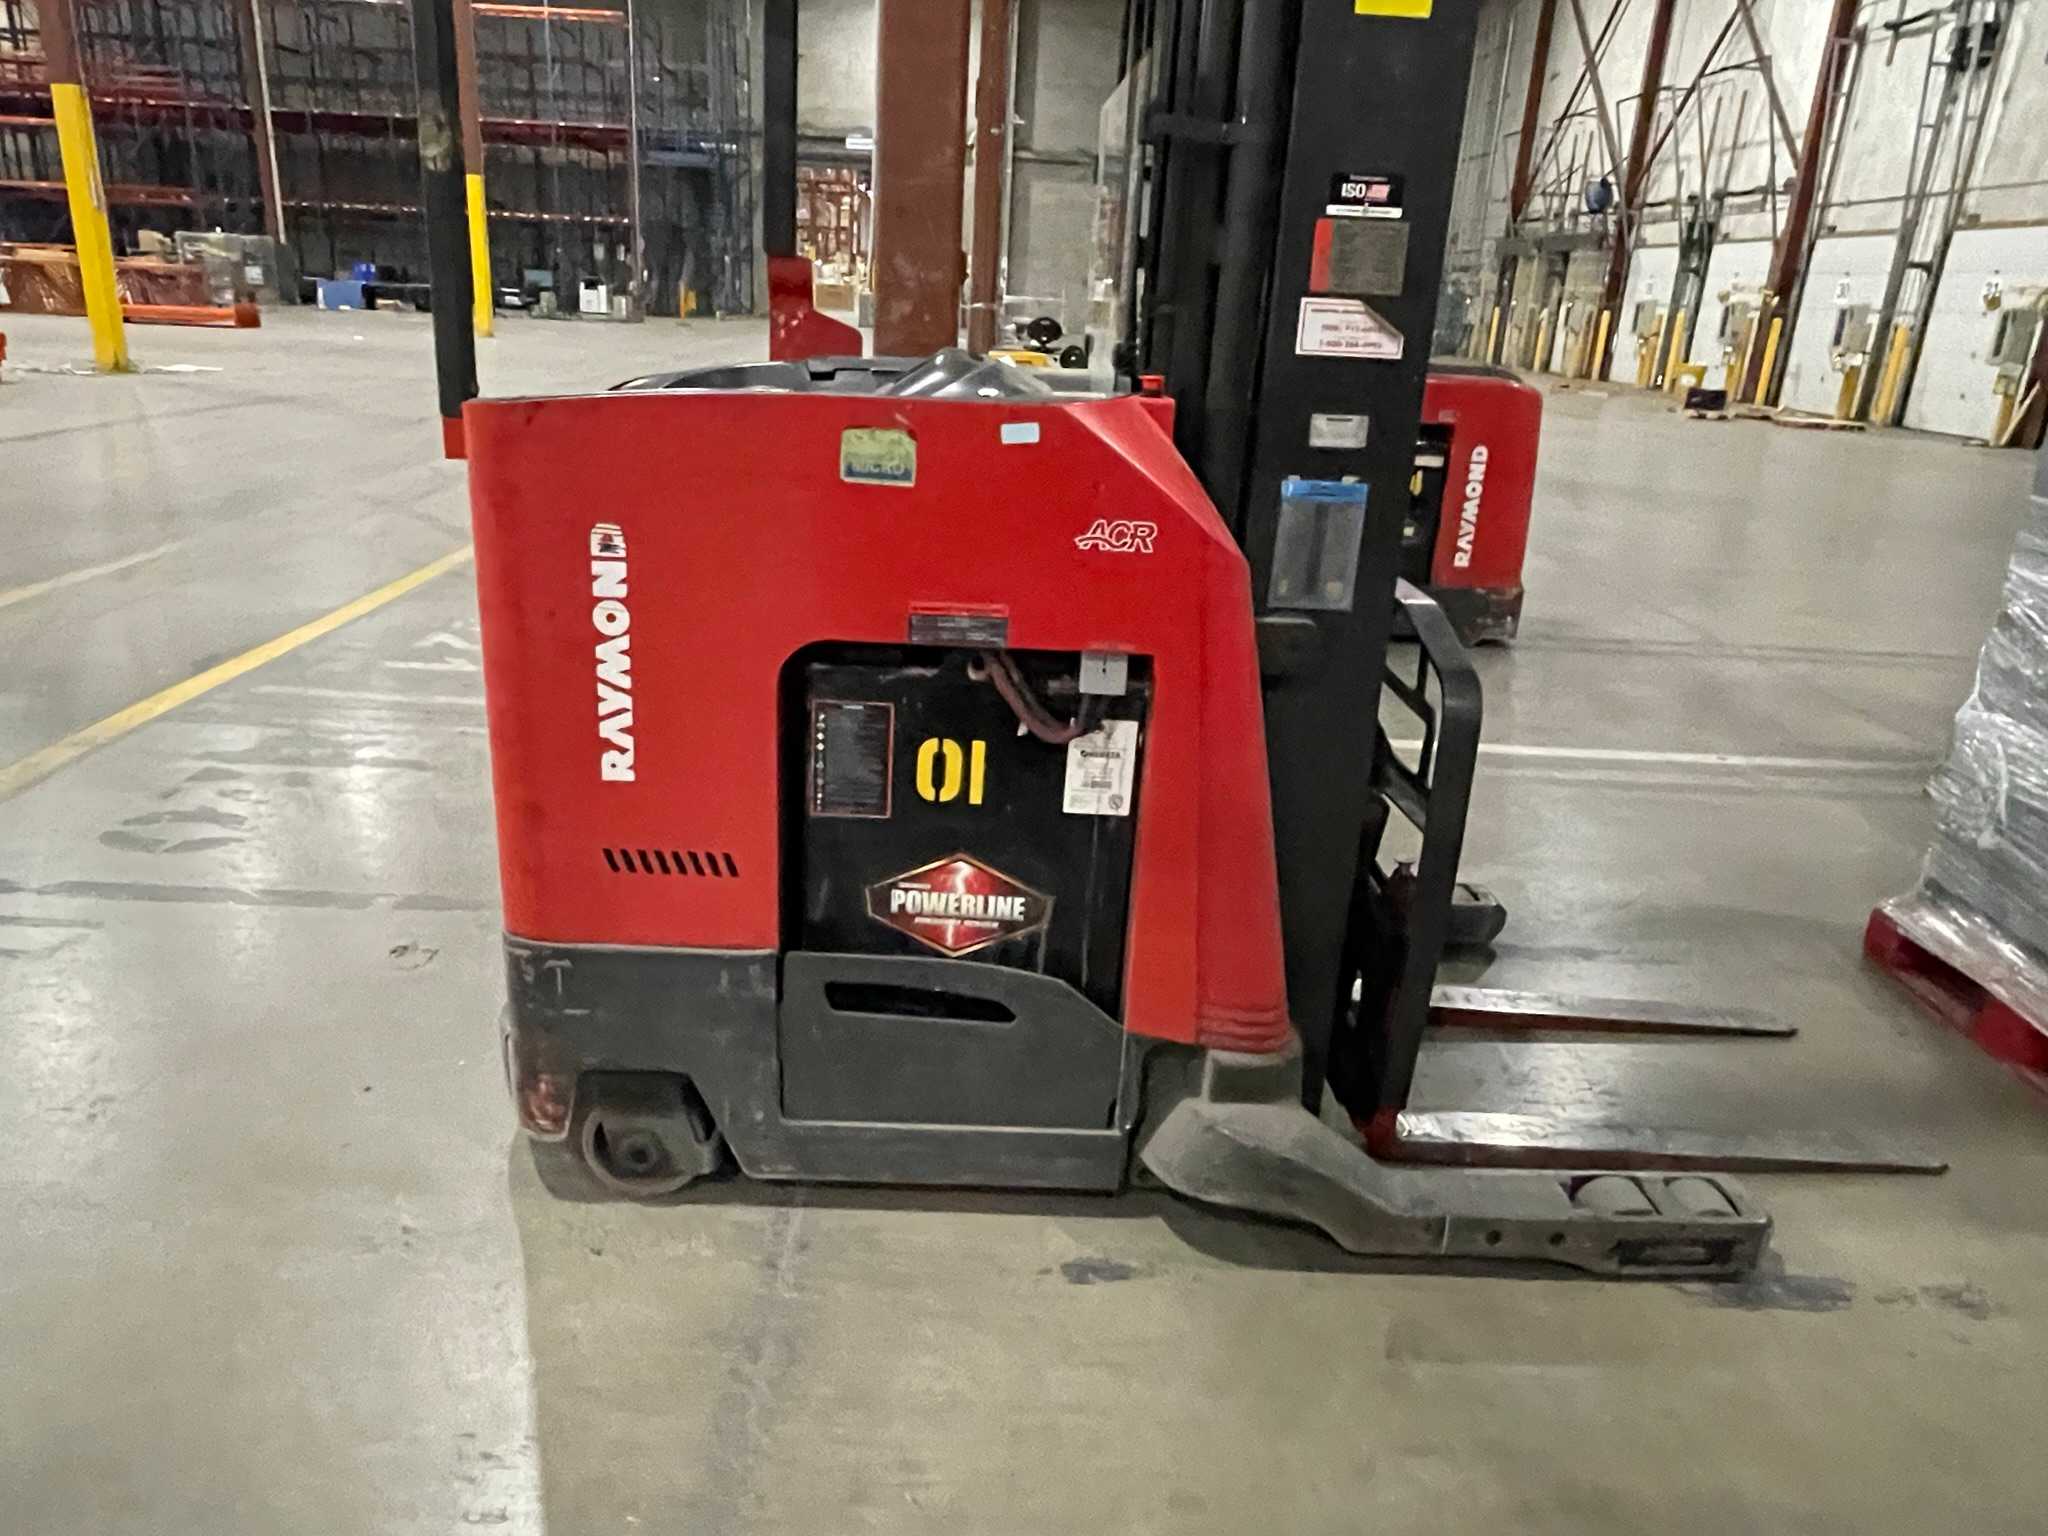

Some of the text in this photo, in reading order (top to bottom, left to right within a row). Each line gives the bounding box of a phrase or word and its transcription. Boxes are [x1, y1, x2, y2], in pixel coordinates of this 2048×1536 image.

[1341, 182, 1367, 198] ISO
[1454, 445, 1489, 567] RAYMOND
[1073, 519, 1158, 553] ACR
[590, 523, 636, 782] RAYMOND
[889, 888, 1027, 922] POWERLINE
